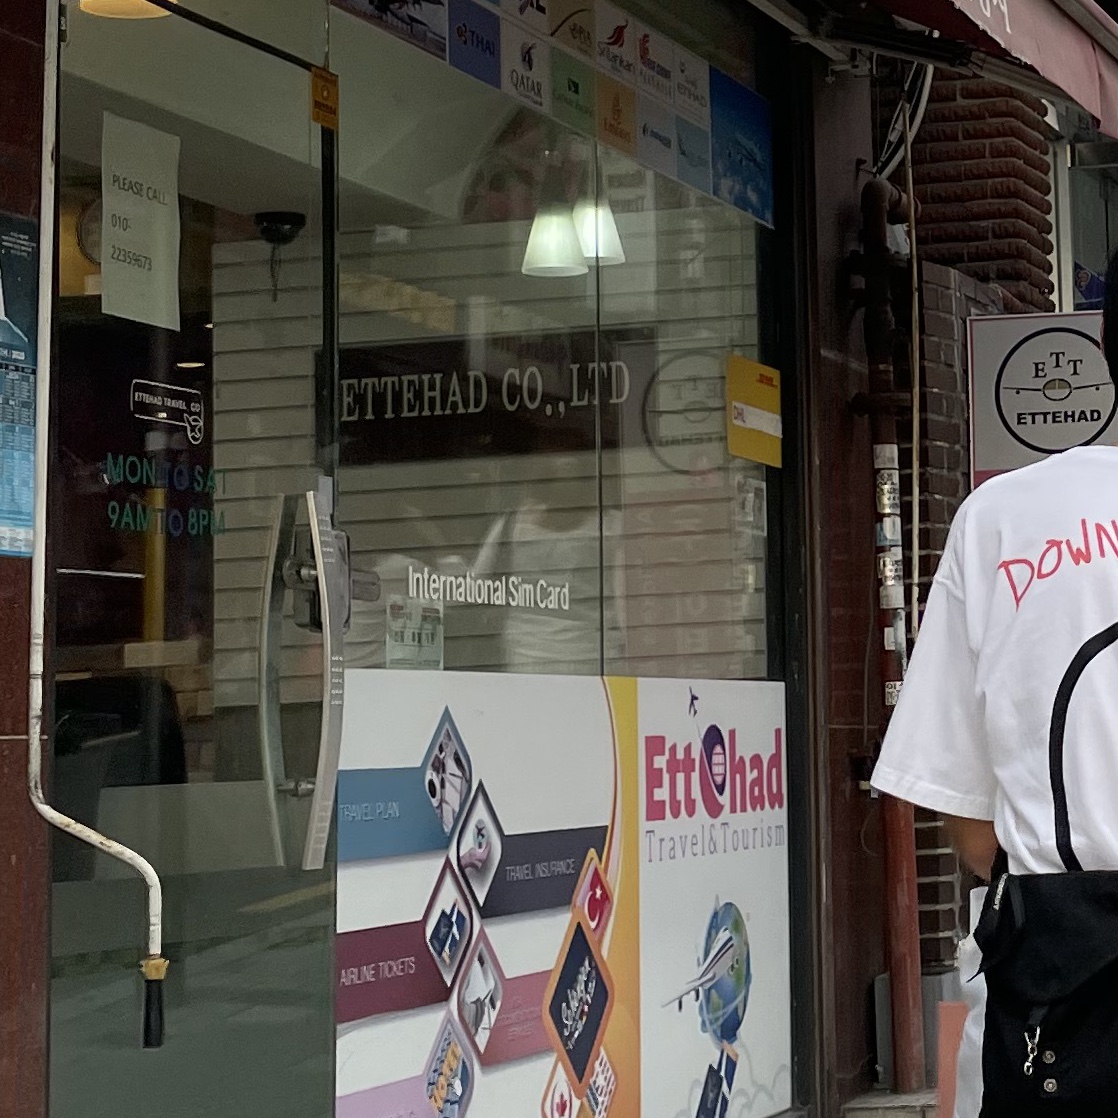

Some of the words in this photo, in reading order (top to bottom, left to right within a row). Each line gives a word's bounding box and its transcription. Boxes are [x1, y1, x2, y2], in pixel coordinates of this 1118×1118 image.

[469, 29, 495, 57] THAI
[510, 69, 543, 99] QATAR
[112, 174, 144, 198] PLEASE
[146, 187, 168, 206] CALL
[111, 214, 131, 231] 010-
[340, 369, 488, 422] ETTEHAD
[1017, 409, 1102, 425] ETTEHAD
[106, 452, 156, 486] MON
[162, 461, 189, 491] TO
[194, 465, 228, 495] SAT
[108, 501, 152, 532] 9AM
[187, 507, 226, 536] 8PM
[408, 565, 506, 606] International
[508, 576, 534, 608] Sim
[536, 579, 570, 610] Card
[339, 803, 374, 821] TRAVEL
[376, 801, 400, 820] PLAN
[505, 864, 534, 881] TRAVEL
[534, 858, 576, 877] INSURANCE
[340, 963, 376, 986] AIRLINE
[378, 957, 416, 979] TICKETS
